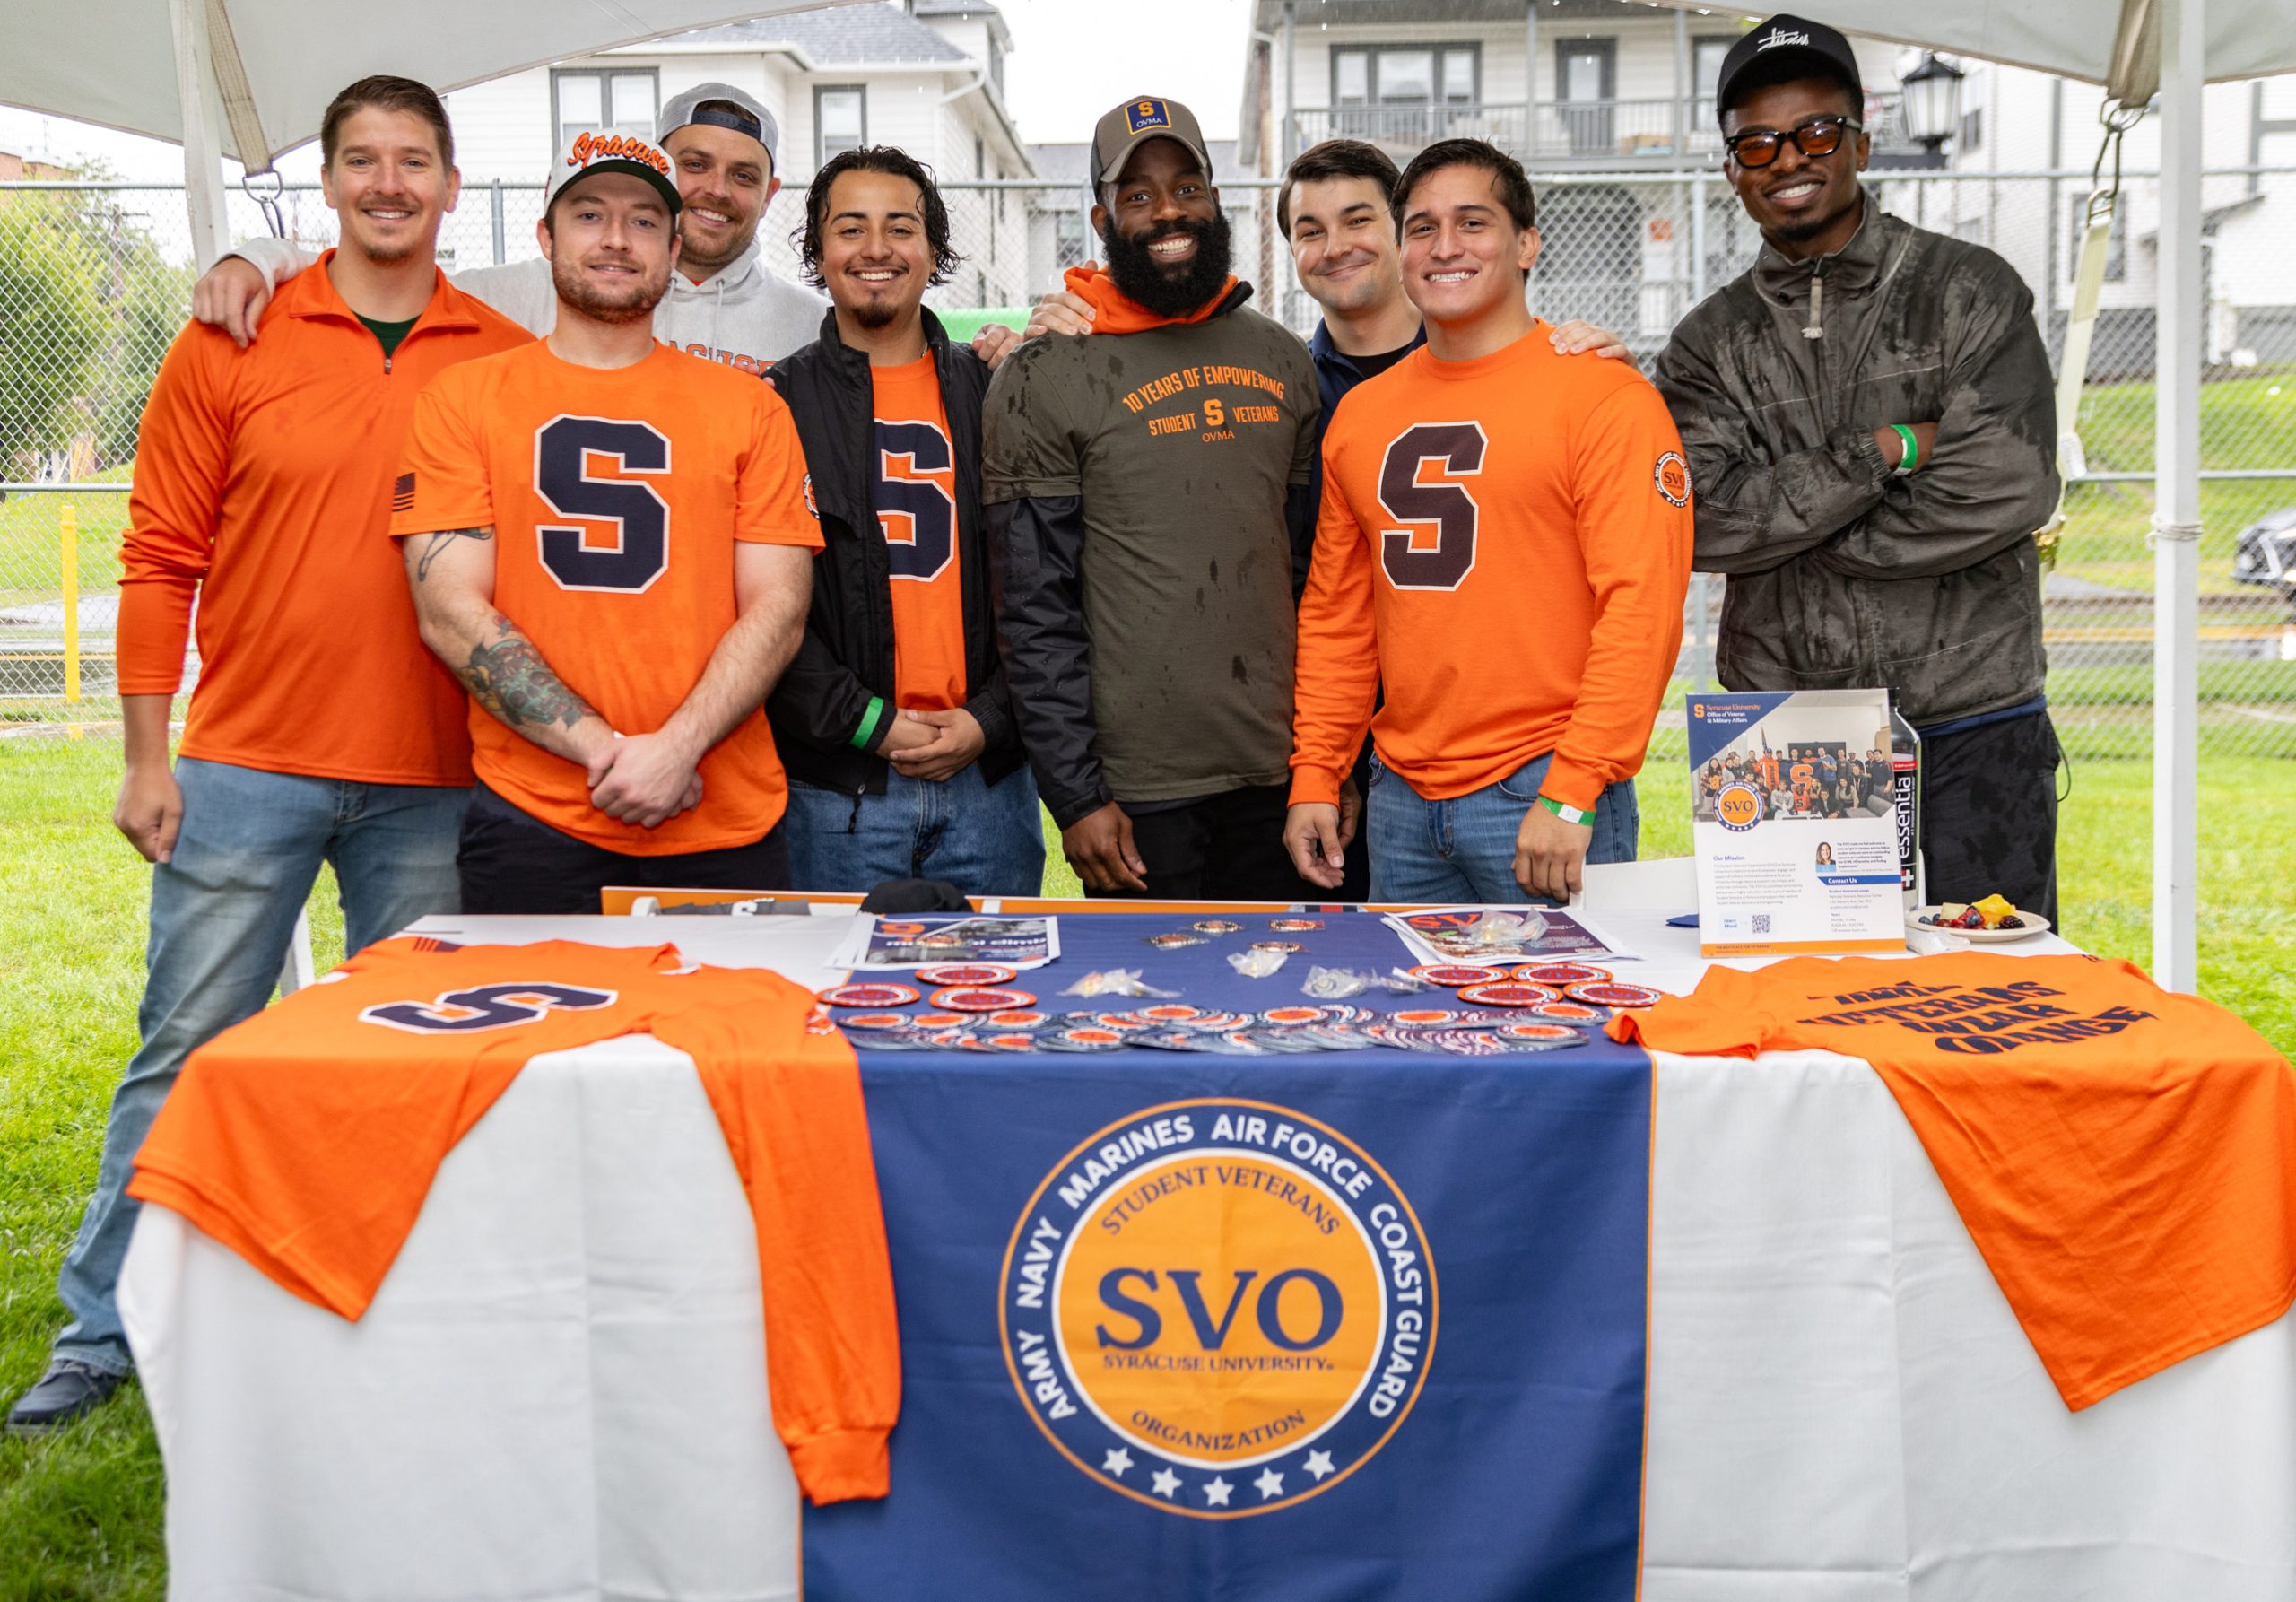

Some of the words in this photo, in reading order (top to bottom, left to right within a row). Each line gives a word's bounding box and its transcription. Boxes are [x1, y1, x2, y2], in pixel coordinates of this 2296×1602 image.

[1136, 118, 1162, 127] OVMA
[1138, 101, 1154, 117] S
[567, 131, 671, 176] Syracuse
[1122, 392, 1145, 414] 10
[1136, 372, 1185, 405] YEARS
[1182, 367, 1201, 388] OF
[1202, 365, 1285, 400] EMPOWERING
[1203, 398, 1225, 426] S
[1148, 413, 1196, 436] STUDENT
[1232, 405, 1280, 423] VETERANS
[1201, 430, 1235, 443] OVMA
[534, 413, 672, 594] S
[874, 417, 956, 582] S
[1377, 420, 1489, 592] S
[1693, 703, 1705, 718] S
[1706, 704, 1732, 712] Syracuse
[1732, 703, 1761, 711] University
[1723, 799, 1754, 813] SVO
[1895, 777, 1911, 858] essentia
[359, 981, 618, 1035] S
[1211, 1113, 1266, 1146] AIR
[1058, 1115, 1194, 1209] MARINES
[1271, 1123, 1374, 1200] FORCE
[1100, 1165, 1209, 1236] STUDENT
[1216, 1165, 1341, 1236] VETERANS
[1016, 1216, 1063, 1309] NAVY
[1370, 1202, 1424, 1305] COAST
[1095, 1267, 1344, 1352] SVO
[1016, 1330, 1077, 1421] ARMY
[1102, 1354, 1206, 1372] SYRACUSE
[1368, 1310, 1424, 1419] GUARD
[1131, 1409, 1307, 1451] ORGANIZATION
